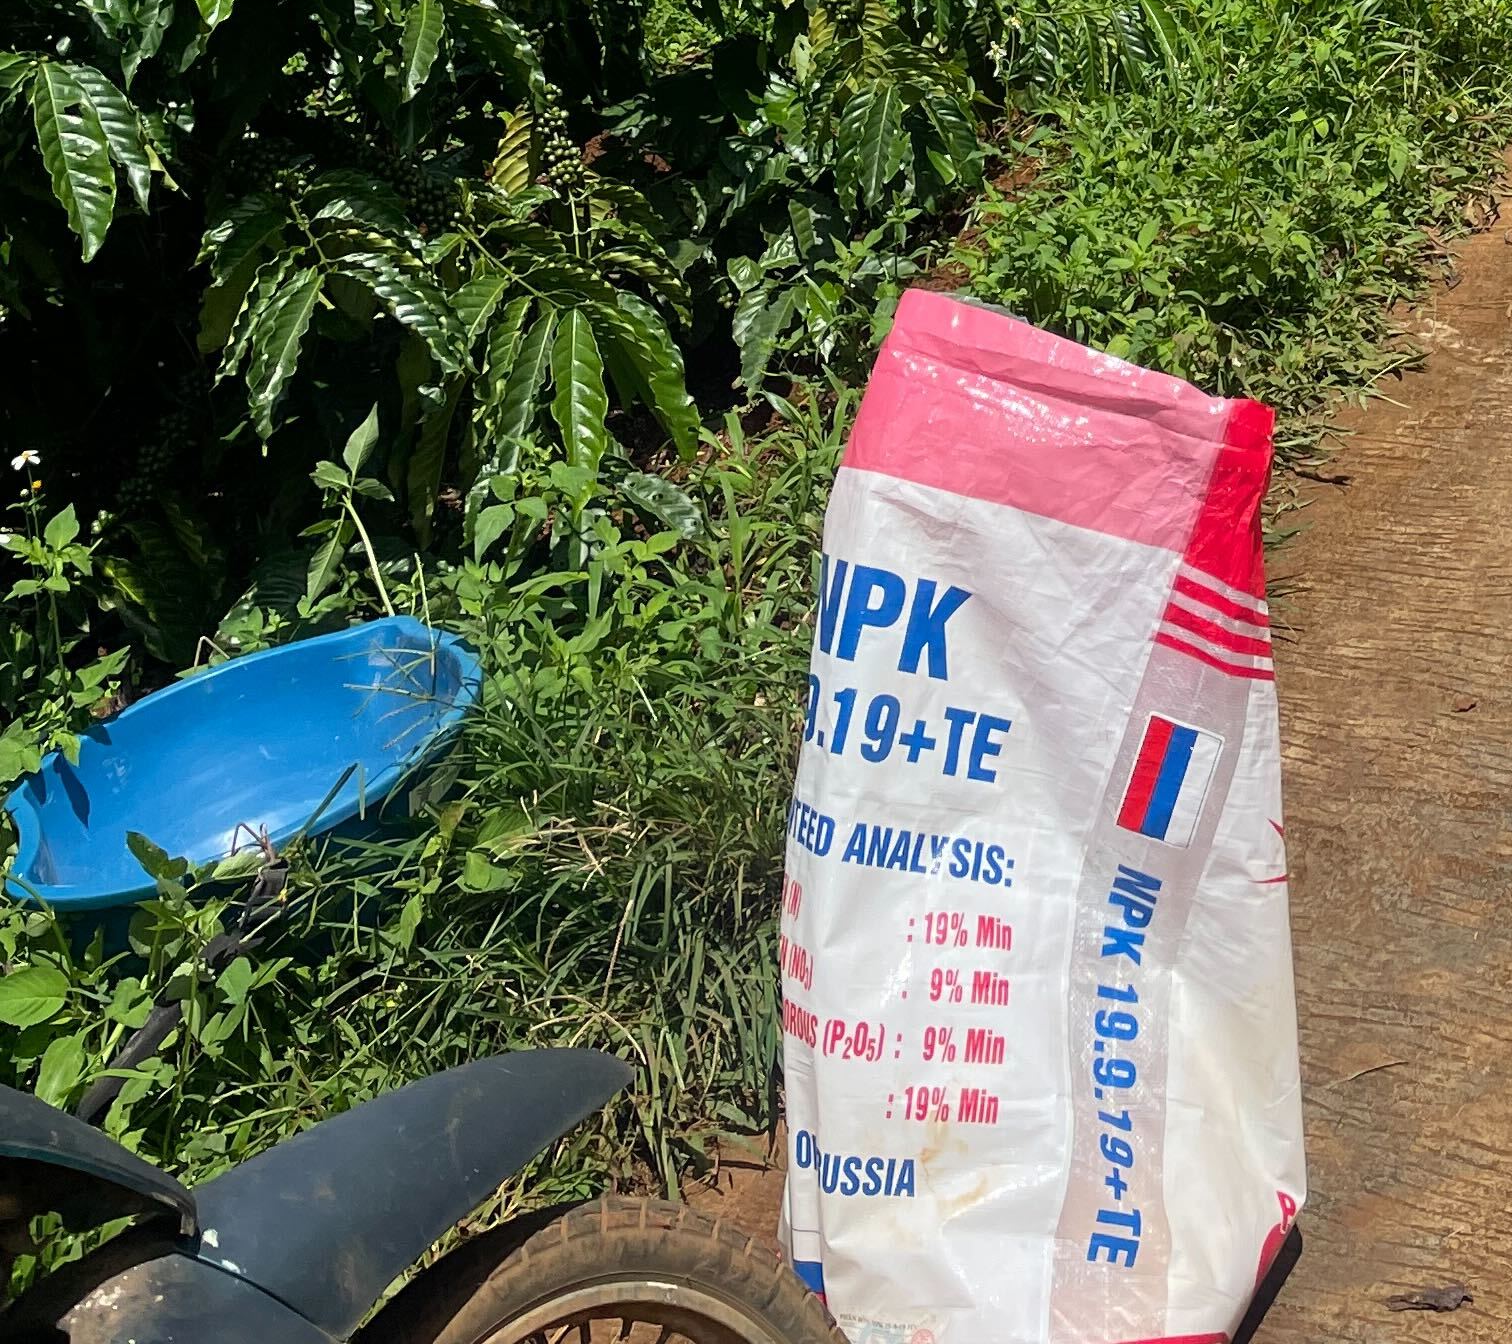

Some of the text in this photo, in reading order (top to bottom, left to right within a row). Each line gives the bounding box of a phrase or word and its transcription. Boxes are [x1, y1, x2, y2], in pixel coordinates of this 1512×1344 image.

[819, 552, 973, 681] NPK
[841, 822, 1015, 887] ANALYSIS:
[924, 911, 968, 947] 19%
[976, 914, 1012, 951] Min
[929, 967, 963, 1003] 9%
[971, 970, 1009, 1006] Min
[923, 1026, 956, 1062] 9%
[964, 1028, 1005, 1064] Min
[1087, 864, 1163, 1268] NPK 19.9.19+TE
[905, 1086, 950, 1123] 19%
[957, 1087, 999, 1124] Min
